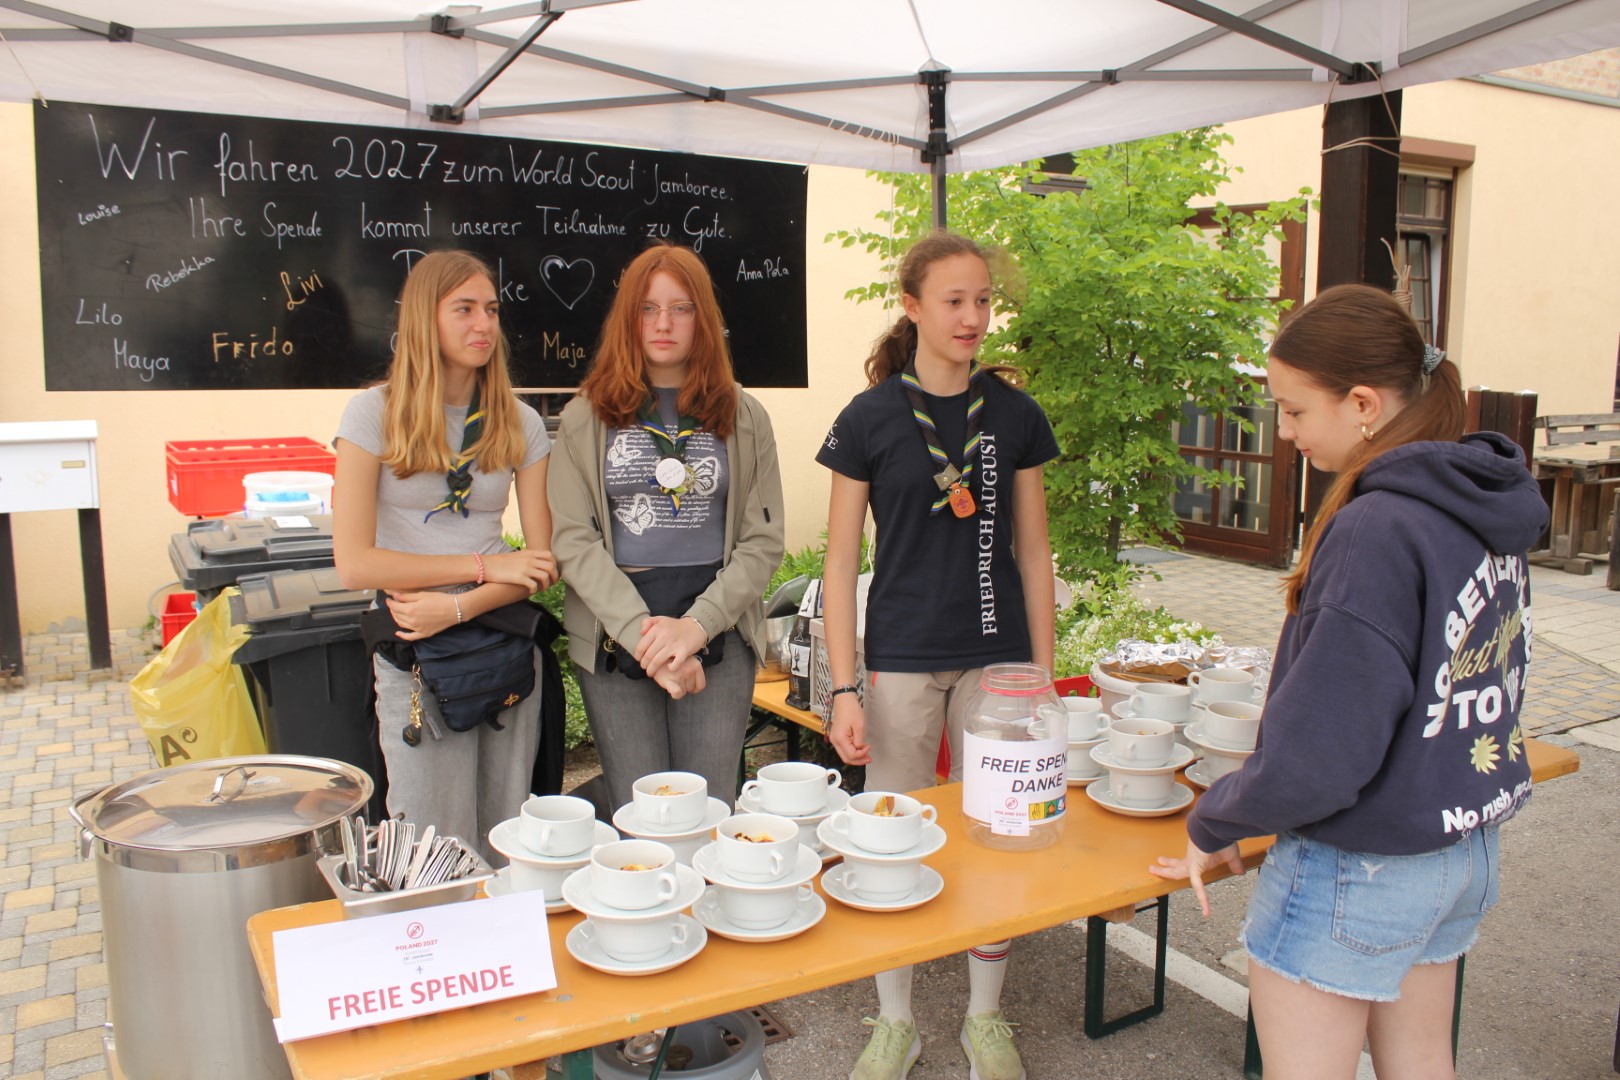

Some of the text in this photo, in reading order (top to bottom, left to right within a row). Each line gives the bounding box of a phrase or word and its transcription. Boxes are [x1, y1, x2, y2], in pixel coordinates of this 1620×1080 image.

[89, 113, 734, 205] Wir fahren 2027 zum World Scout Jamboree.
[78, 204, 121, 226] Louise
[189, 197, 733, 253] Ihre Spende kommt unserer Teilnahme zu Gute.
[146, 257, 216, 292] Rebekka
[736, 258, 762, 282] Anna
[75, 298, 123, 326] Lilo
[113, 338, 170, 383] Maya
[212, 326, 294, 362] Frido
[543, 331, 586, 368] Maja
[978, 431, 998, 636] FRIEDRICH AUGUST
[1453, 686, 1502, 730] TO
[981, 756, 1031, 773] FREIE
[1011, 772, 1063, 793] DANKE
[1442, 807, 1480, 833] No
[395, 939, 438, 951] POLAND 2027
[328, 965, 514, 1020] FREIE SPENDE
